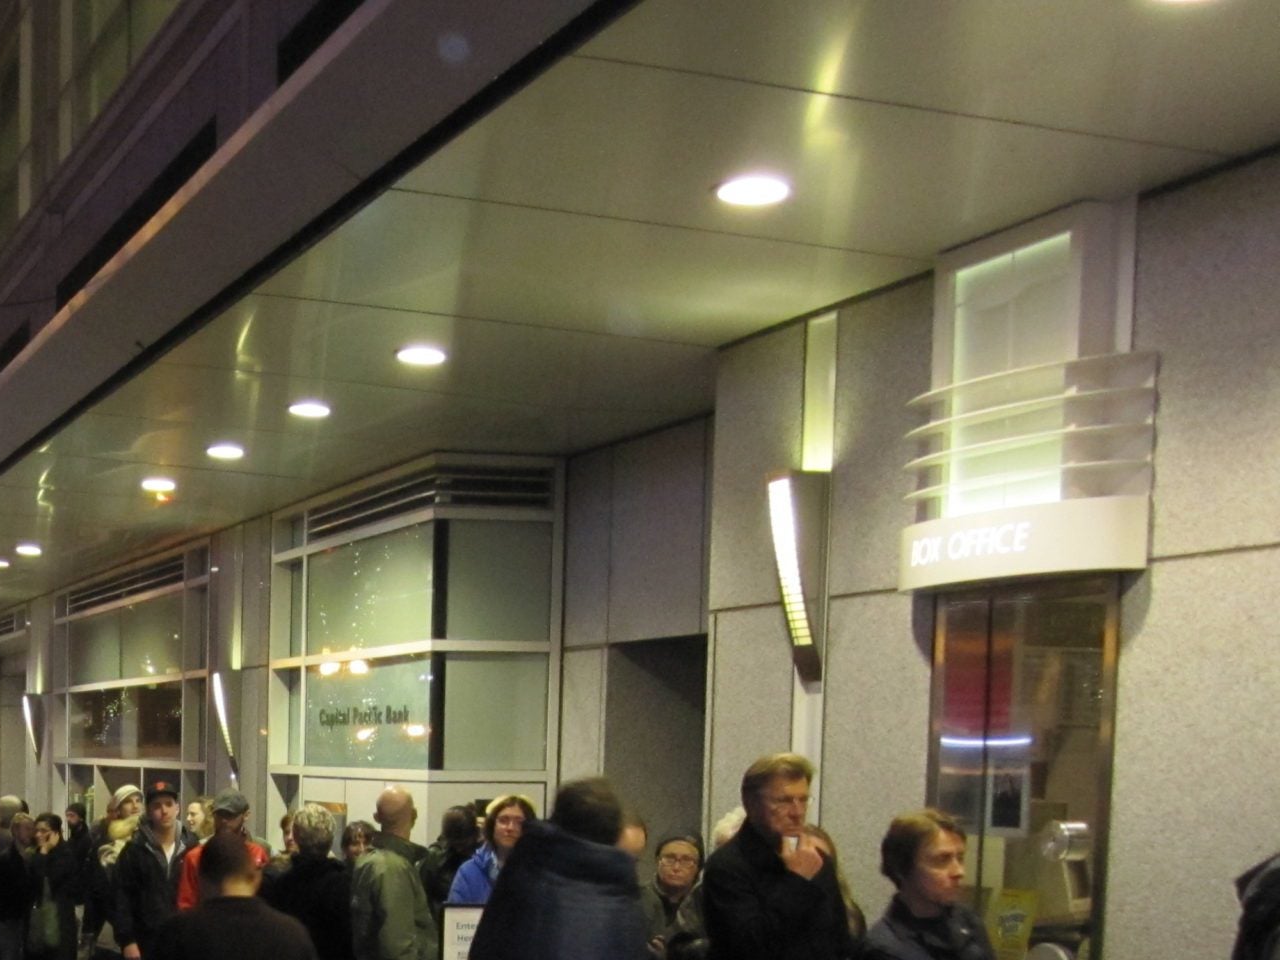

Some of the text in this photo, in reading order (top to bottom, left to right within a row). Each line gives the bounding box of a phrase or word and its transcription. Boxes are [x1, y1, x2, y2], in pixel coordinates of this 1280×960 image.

[910, 522, 1031, 567] BOX OFFICE
[319, 704, 410, 731] Capital Pacific Bank
[455, 922, 477, 930] Ente
